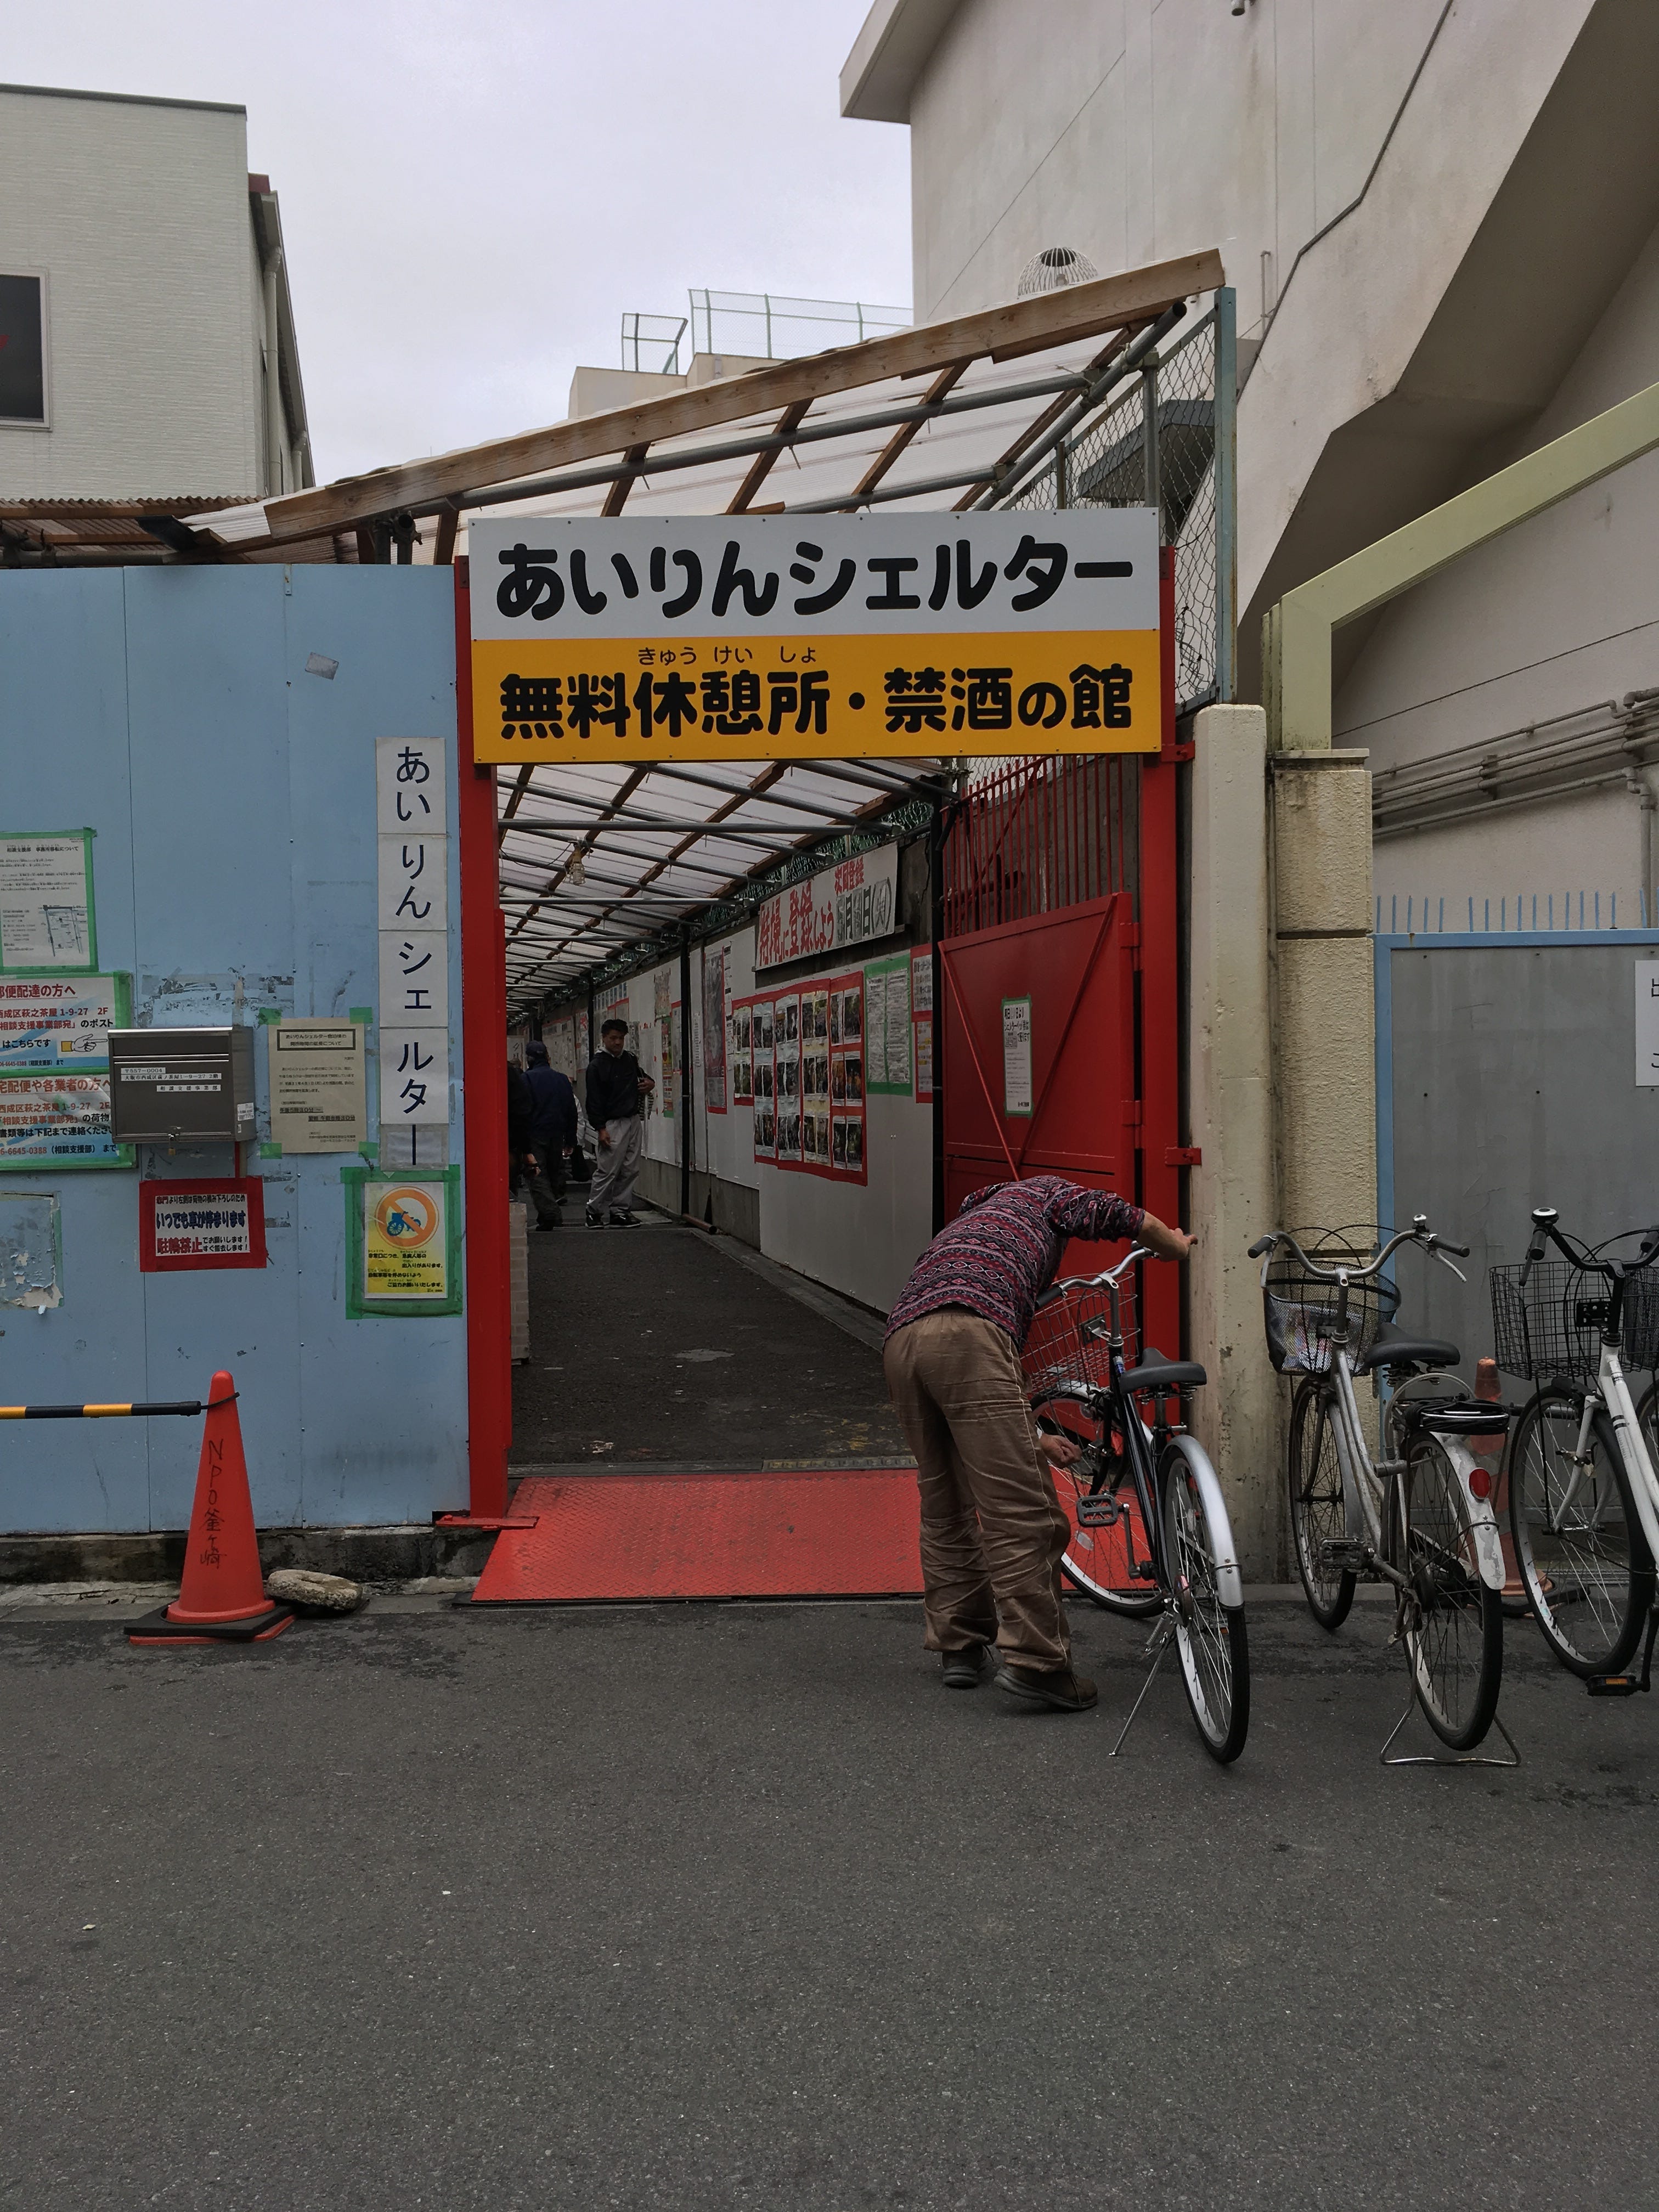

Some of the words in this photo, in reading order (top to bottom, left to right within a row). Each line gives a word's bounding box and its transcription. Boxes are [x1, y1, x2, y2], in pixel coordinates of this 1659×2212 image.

[496, 535, 1133, 620] あいりんシェルター
[638, 646, 697, 665] きゅう
[714, 646, 753, 664] けい
[780, 645, 816, 664] しょ
[500, 663, 1132, 740] 無料休憩所・禁酒の館
[396, 747, 434, 1166] あいりんシェルター
[62, 1102, 91, 1110] 1-9-27
[156, 1210, 246, 1229] いつでも車が停まります
